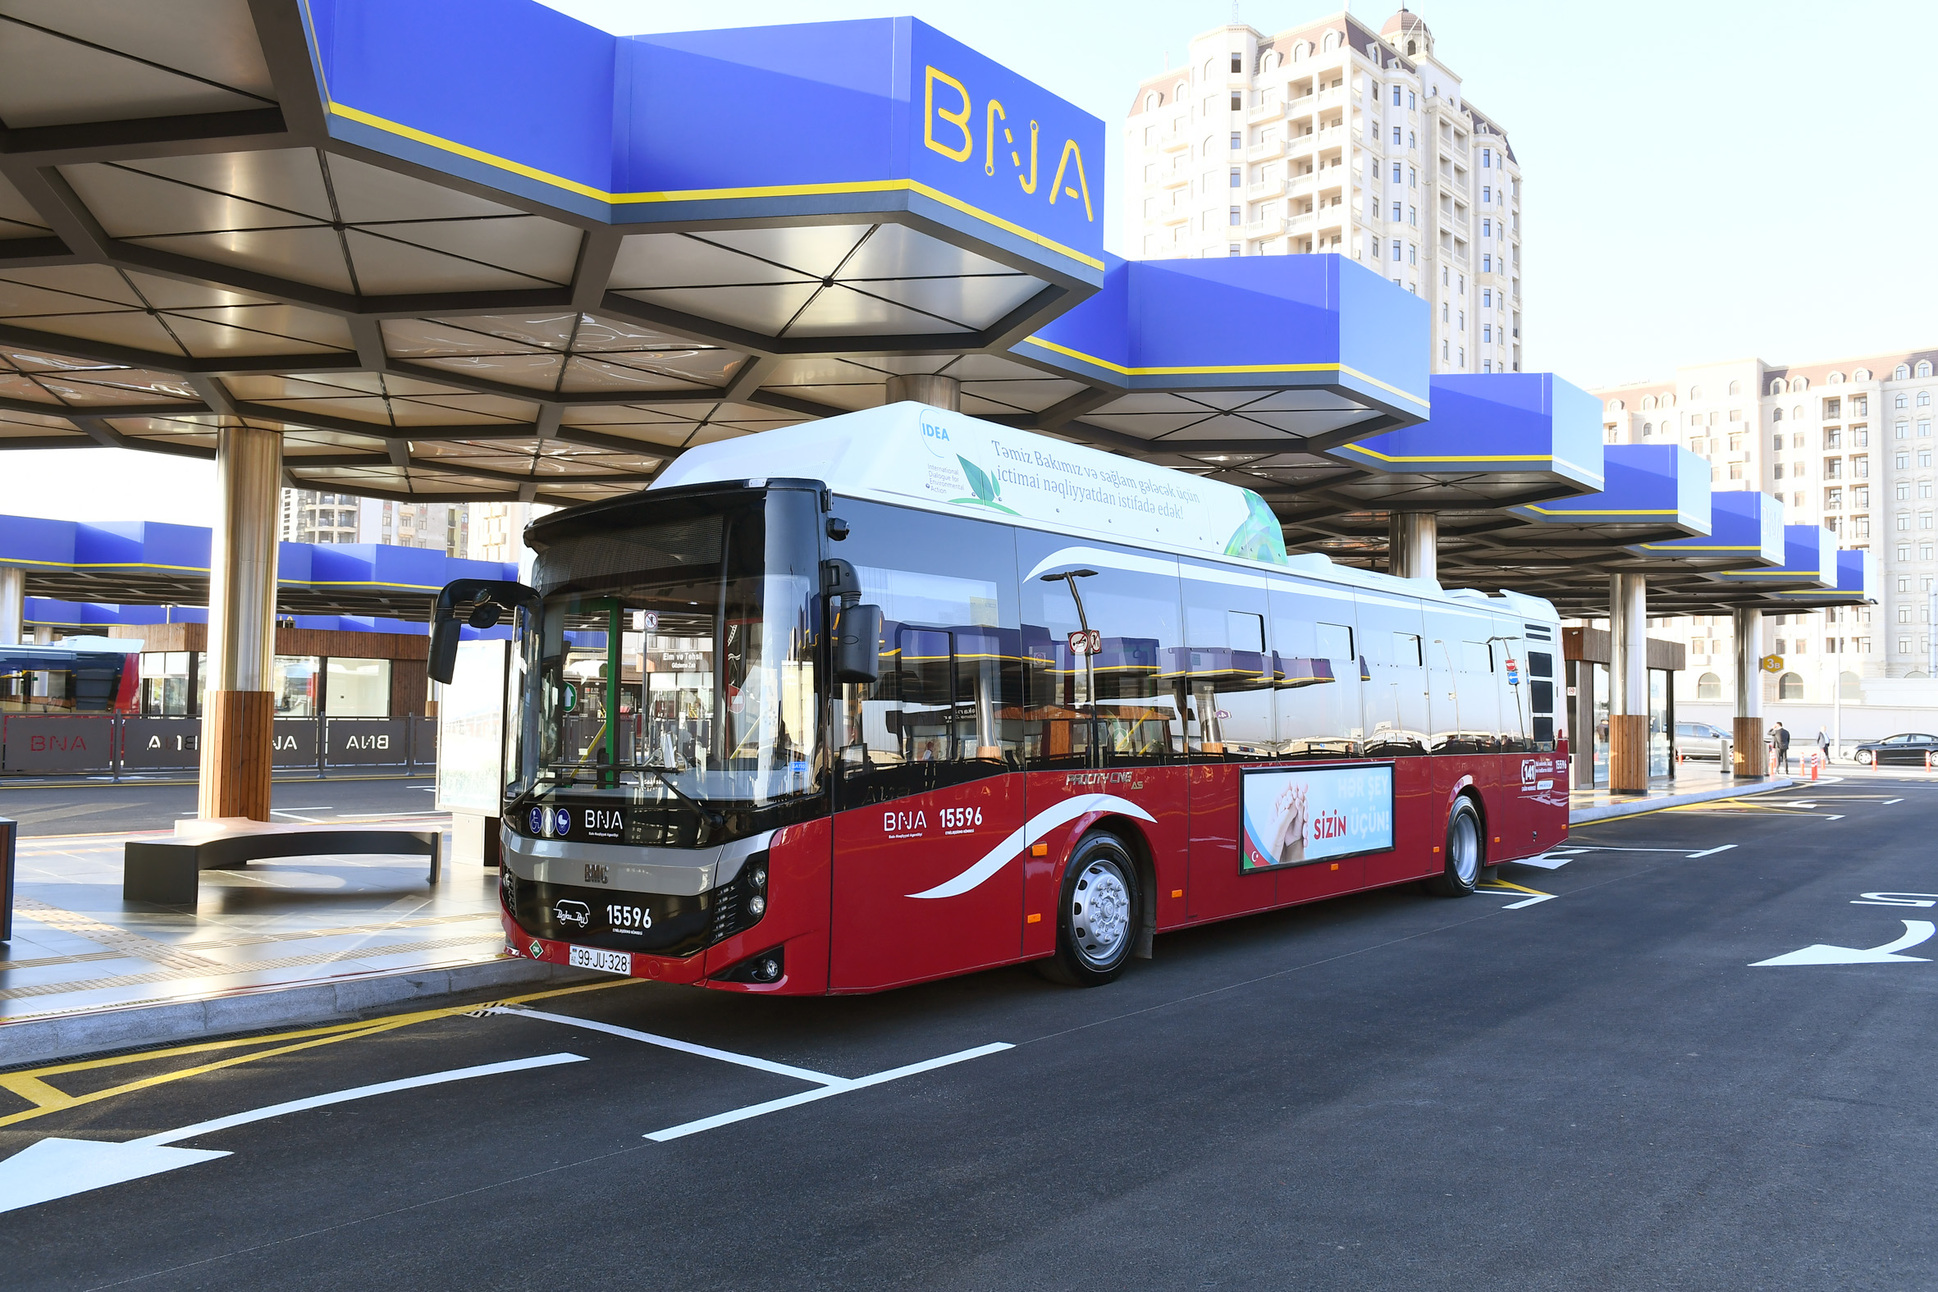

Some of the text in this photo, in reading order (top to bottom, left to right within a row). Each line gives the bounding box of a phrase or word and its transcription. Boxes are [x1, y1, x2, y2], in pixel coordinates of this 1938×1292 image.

[924, 64, 1094, 222] BNA
[922, 423, 950, 442] IDEA
[991, 440, 1201, 504] Təmiz Bakımız və sağlam gələcək üçün
[997, 464, 1184, 520] ictimai nəqliyyatdan istifadə edək!
[1767, 658, 1780, 669] 3B
[30, 735, 87, 752] BNA
[1338, 775, 1389, 802] HƏR ŞEY
[585, 809, 623, 830] BNA
[884, 810, 927, 832] BNA
[939, 806, 983, 828] 15596
[1313, 806, 1390, 840] SİZİN ÜÇÜN!
[584, 863, 609, 884] BMC
[606, 904, 652, 929] 15596
[577, 949, 628, 972] 99-JU-328
